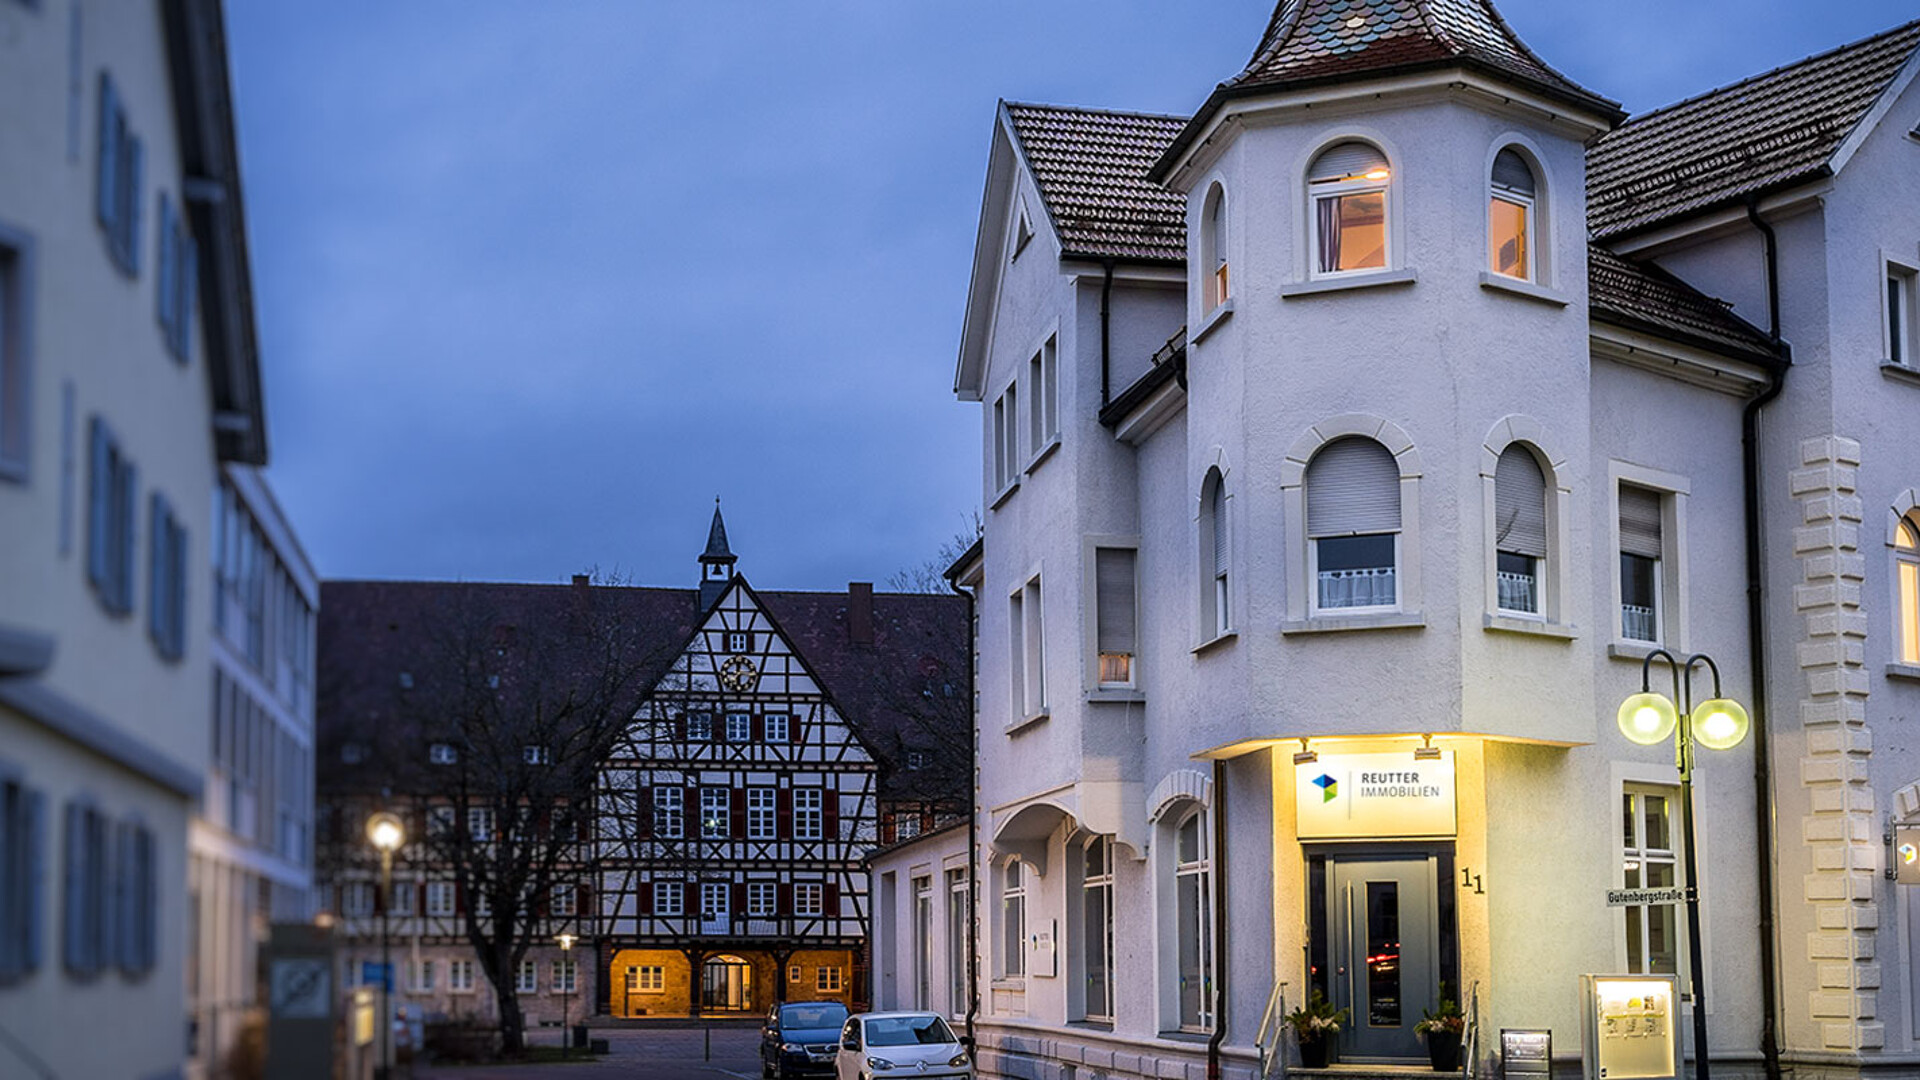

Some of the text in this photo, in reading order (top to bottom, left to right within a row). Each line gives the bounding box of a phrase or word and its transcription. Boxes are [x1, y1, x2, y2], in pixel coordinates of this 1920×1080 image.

[1361, 772, 1419, 784] REUTTER
[1361, 786, 1439, 797] IMMOBILIEN
[1461, 867, 1485, 894] 11
[1608, 889, 1682, 903] Gutenbergstraße
